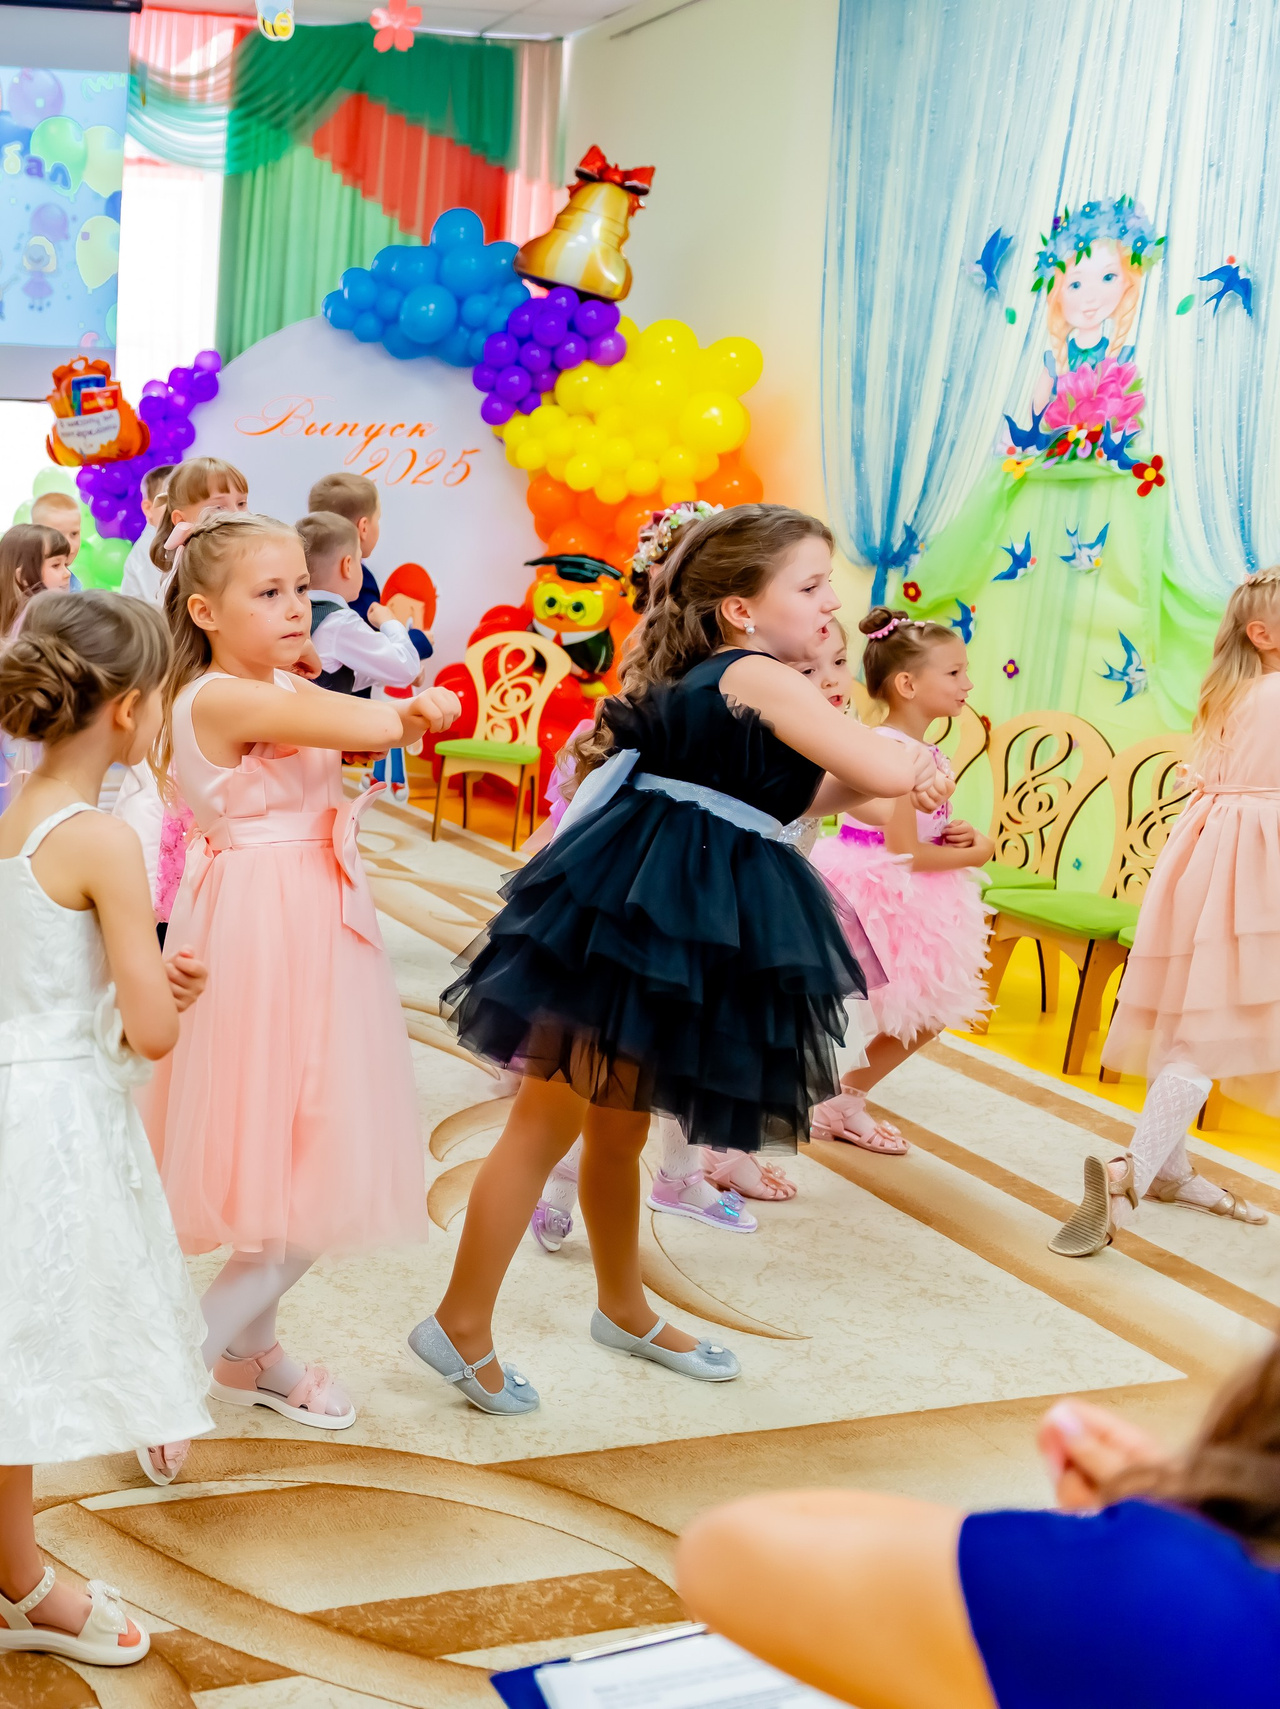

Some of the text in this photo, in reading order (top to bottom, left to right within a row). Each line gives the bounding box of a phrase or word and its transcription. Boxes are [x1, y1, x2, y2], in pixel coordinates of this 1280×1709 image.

[3, 143, 71, 188] бал
[235, 395, 439, 466] Выпуск
[361, 447, 481, 487] 2025
